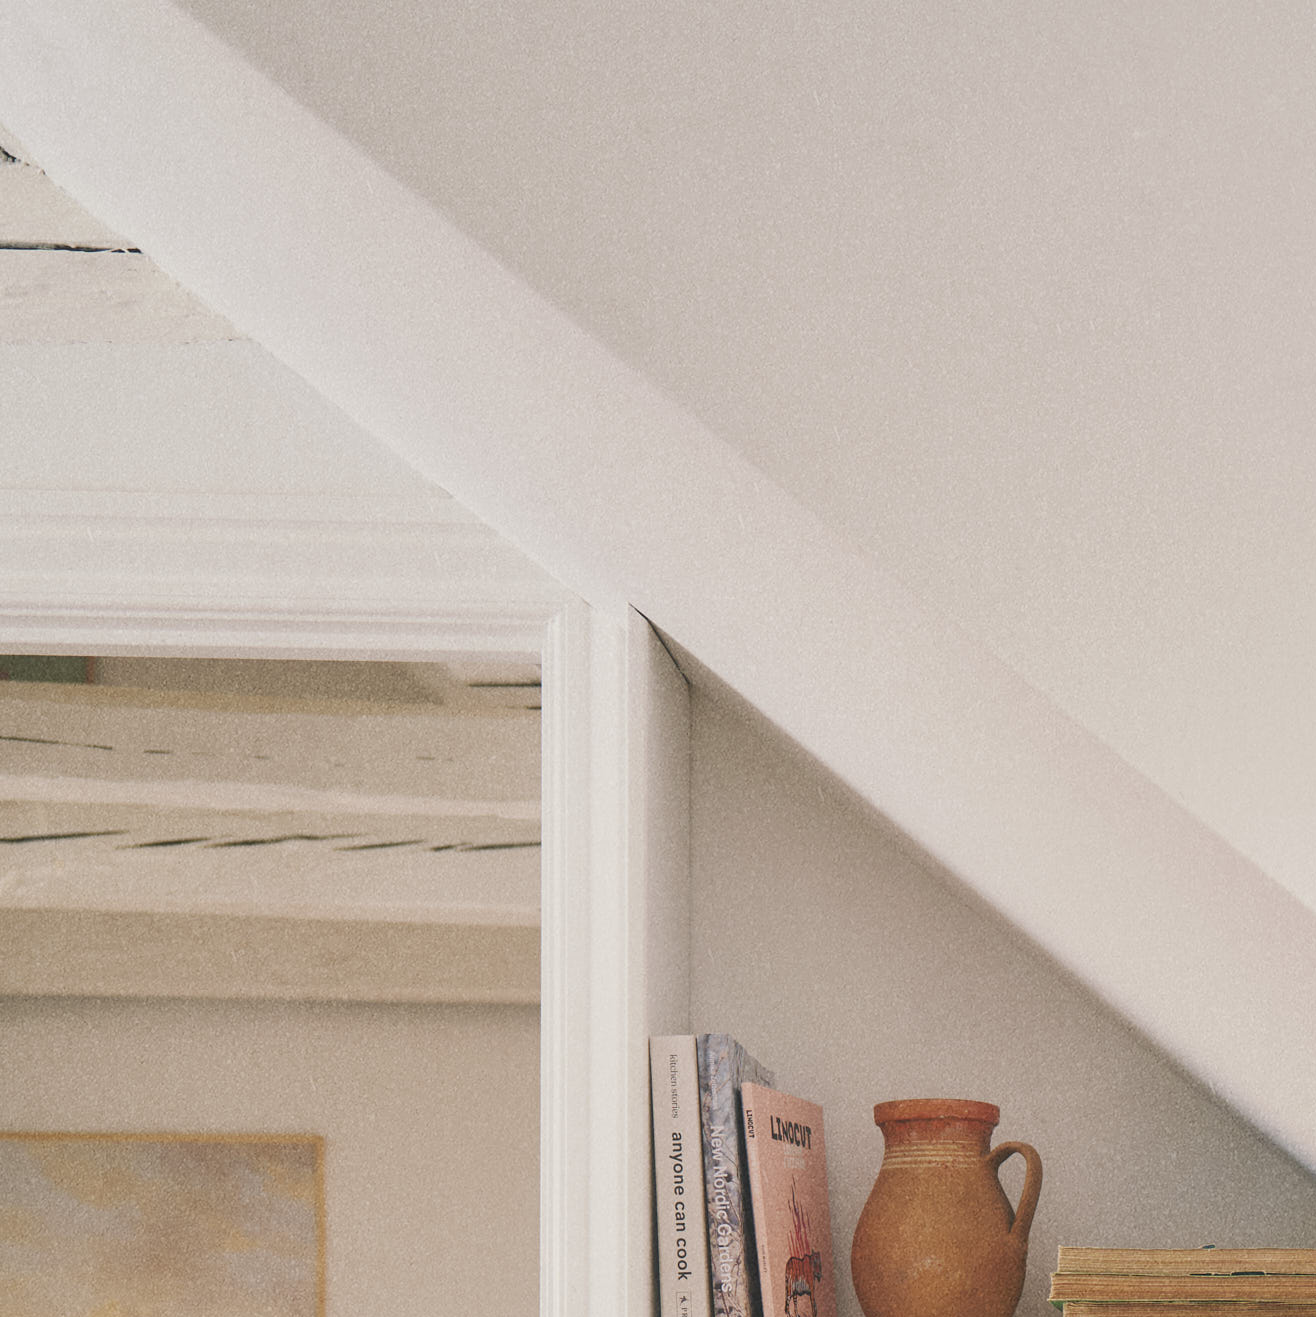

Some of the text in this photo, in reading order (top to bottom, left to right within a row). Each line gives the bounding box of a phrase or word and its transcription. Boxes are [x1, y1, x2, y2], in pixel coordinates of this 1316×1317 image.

[669, 1054, 680, 1119] kitchen stories
[746, 1110, 755, 1139] LINOCUT
[770, 1115, 812, 1149] LINOCUT
[669, 1132, 692, 1280] anyone can cook
[710, 1125, 734, 1292] New Nordic Gardens
